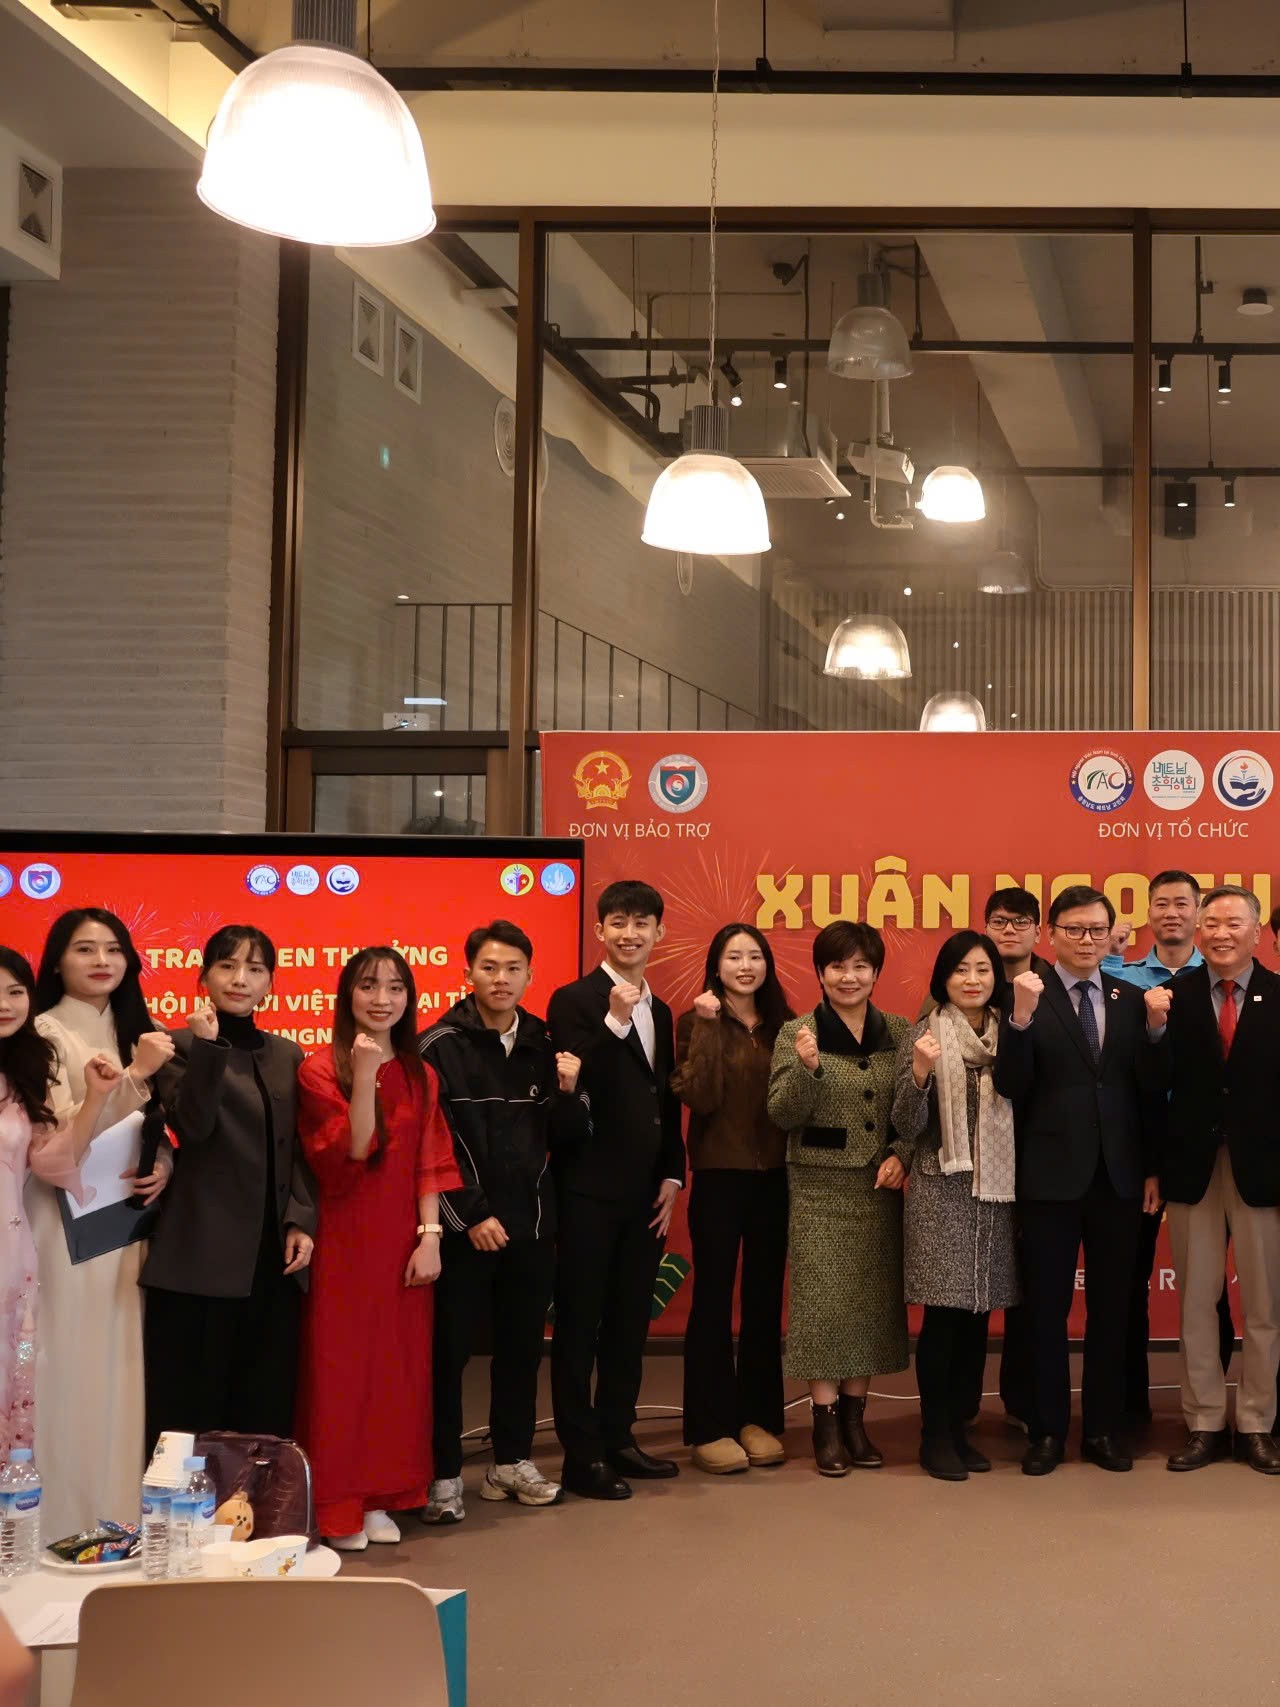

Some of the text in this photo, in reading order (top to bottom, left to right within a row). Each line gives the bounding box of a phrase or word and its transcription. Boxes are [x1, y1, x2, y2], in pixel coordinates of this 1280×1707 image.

[1152, 762, 1188, 778] 베트남
[1152, 775, 1196, 792] 총학생회
[569, 818, 712, 840] ĐƠN VỊ BẢO TRỢ
[1098, 817, 1249, 840] ĐƠN VỊ TỔ CHỨC
[756, 855, 970, 929] XUÂN
[995, 872, 1150, 946] NỌ
[285, 988, 337, 1016] VIỆT
[417, 992, 440, 1014] ẠI
